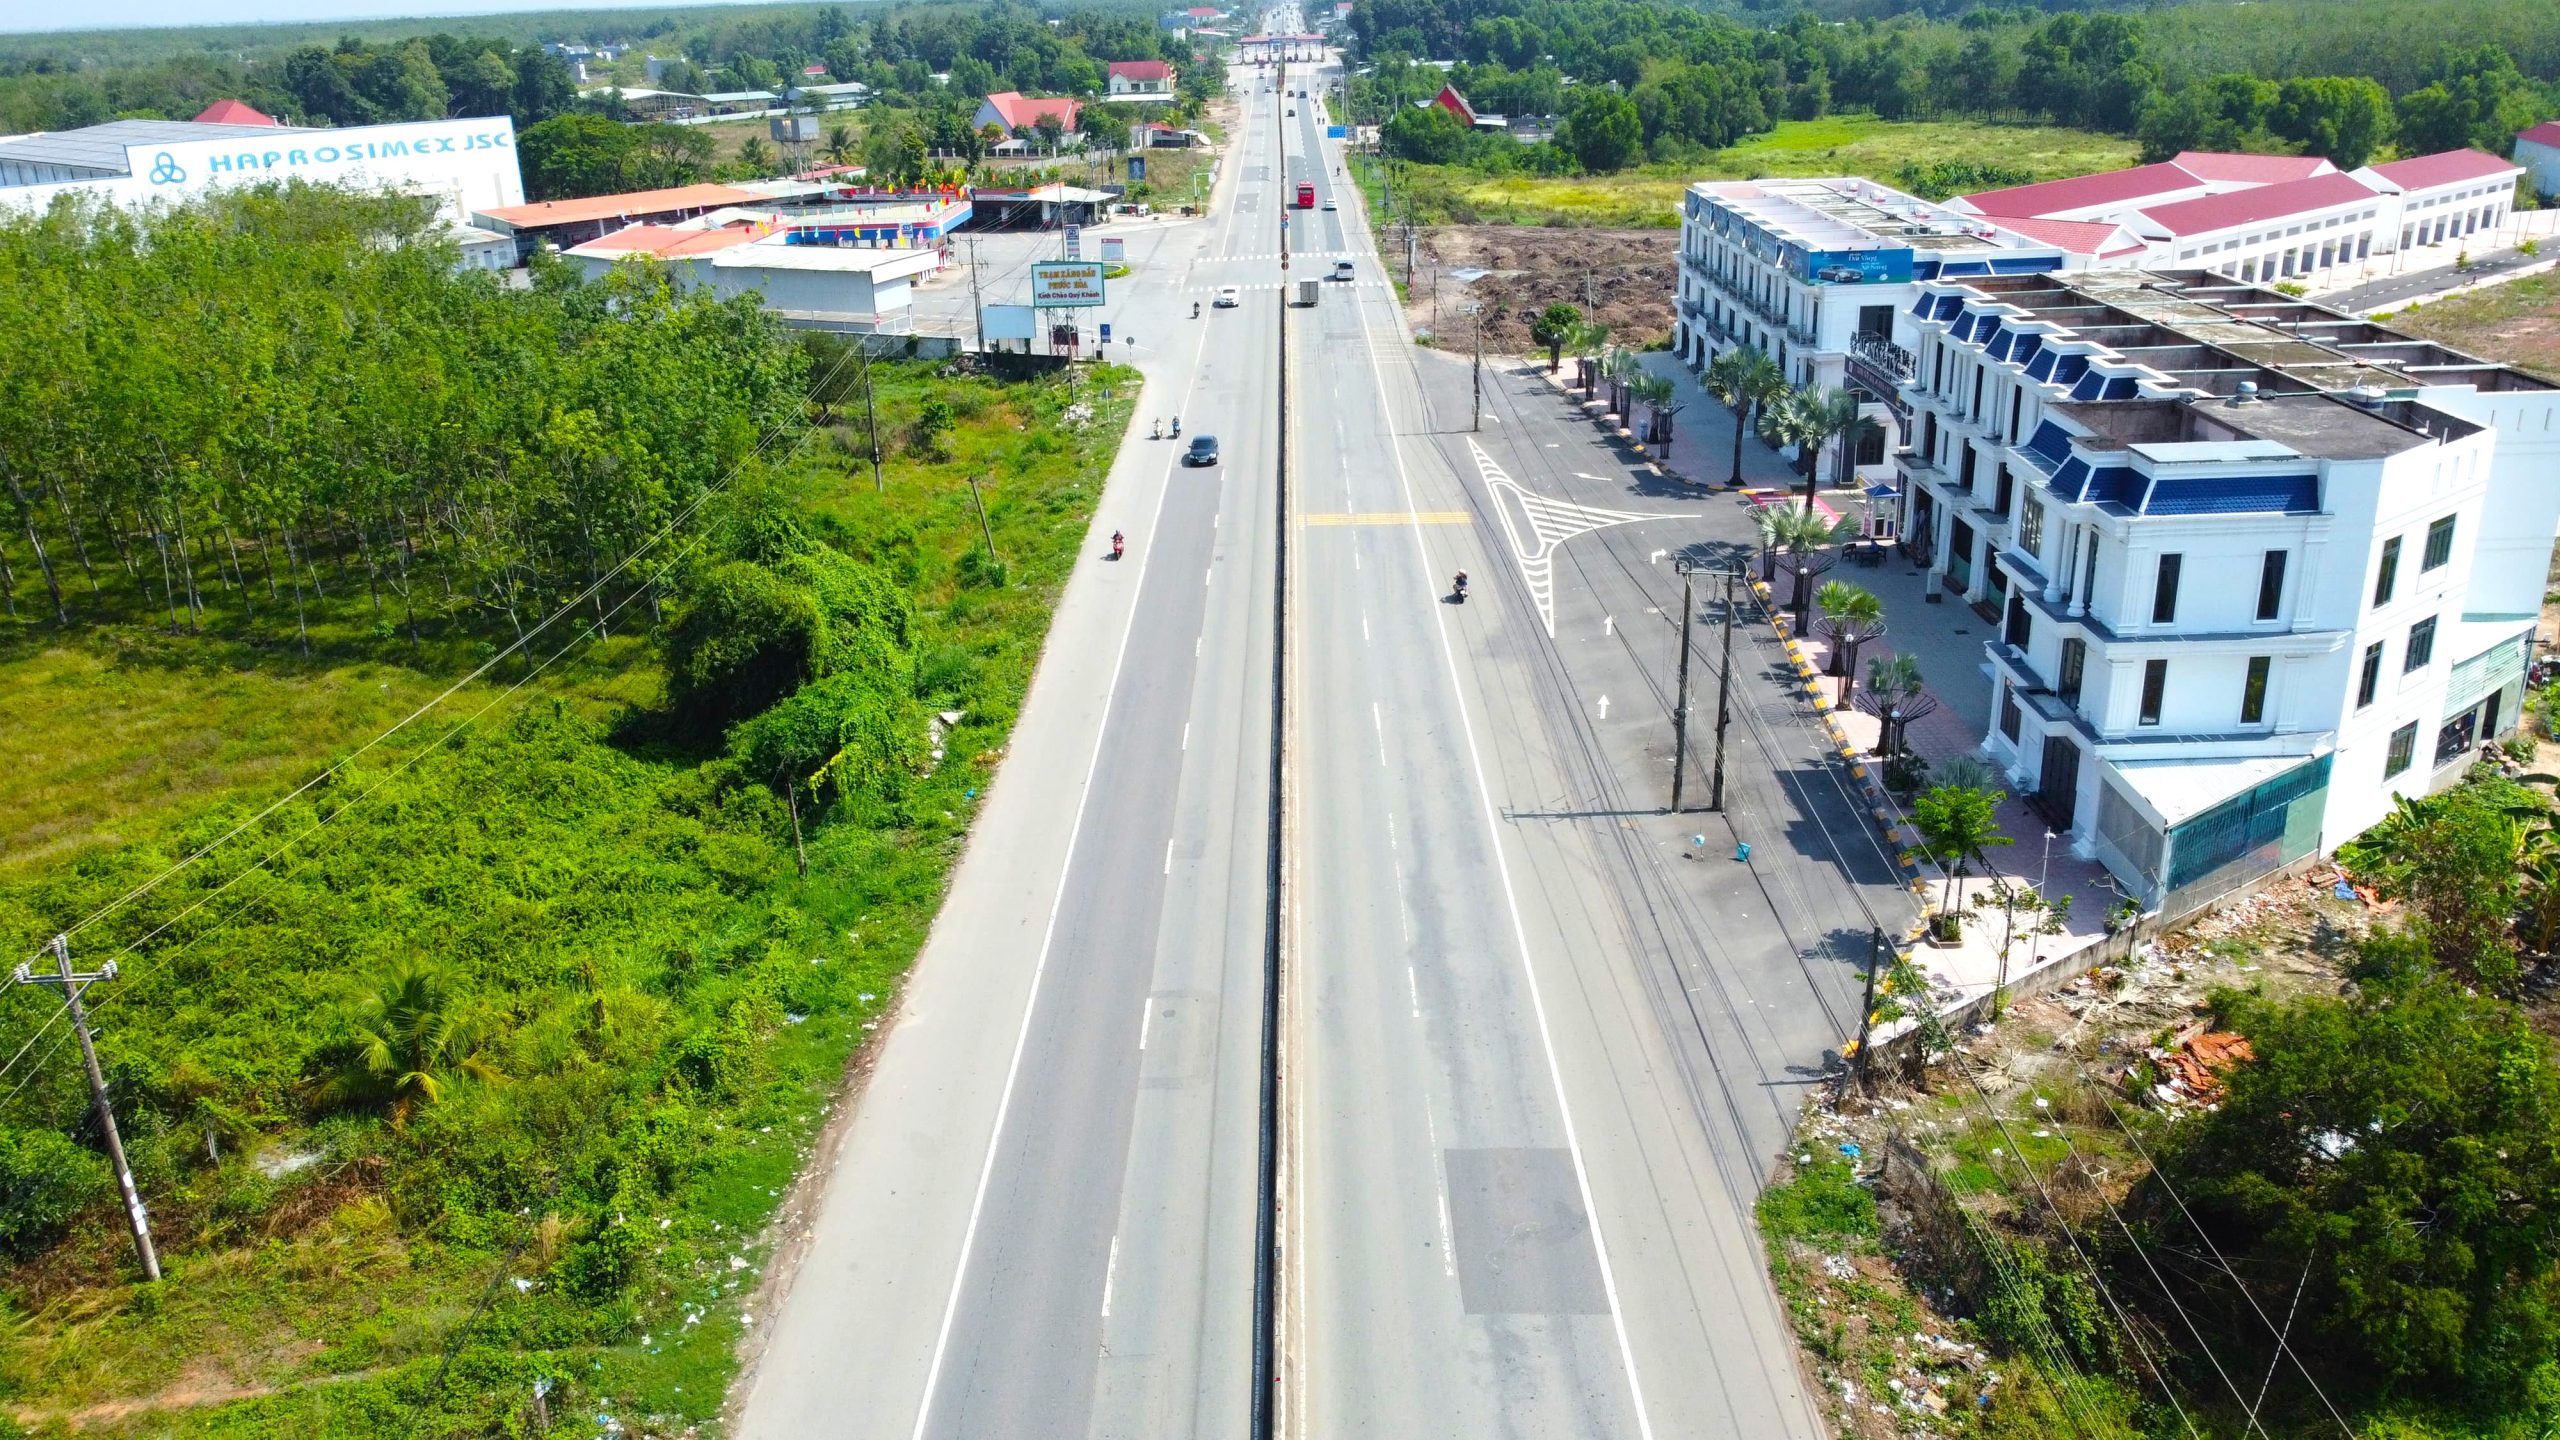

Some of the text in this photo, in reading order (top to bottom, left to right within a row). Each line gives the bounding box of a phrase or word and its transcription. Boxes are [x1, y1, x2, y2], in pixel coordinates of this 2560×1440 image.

[209, 132, 509, 173] HAPROSIMEX JSC
[1038, 291, 1051, 299] Kính
[1052, 291, 1068, 299] Chào
[1068, 291, 1080, 299] Quý
